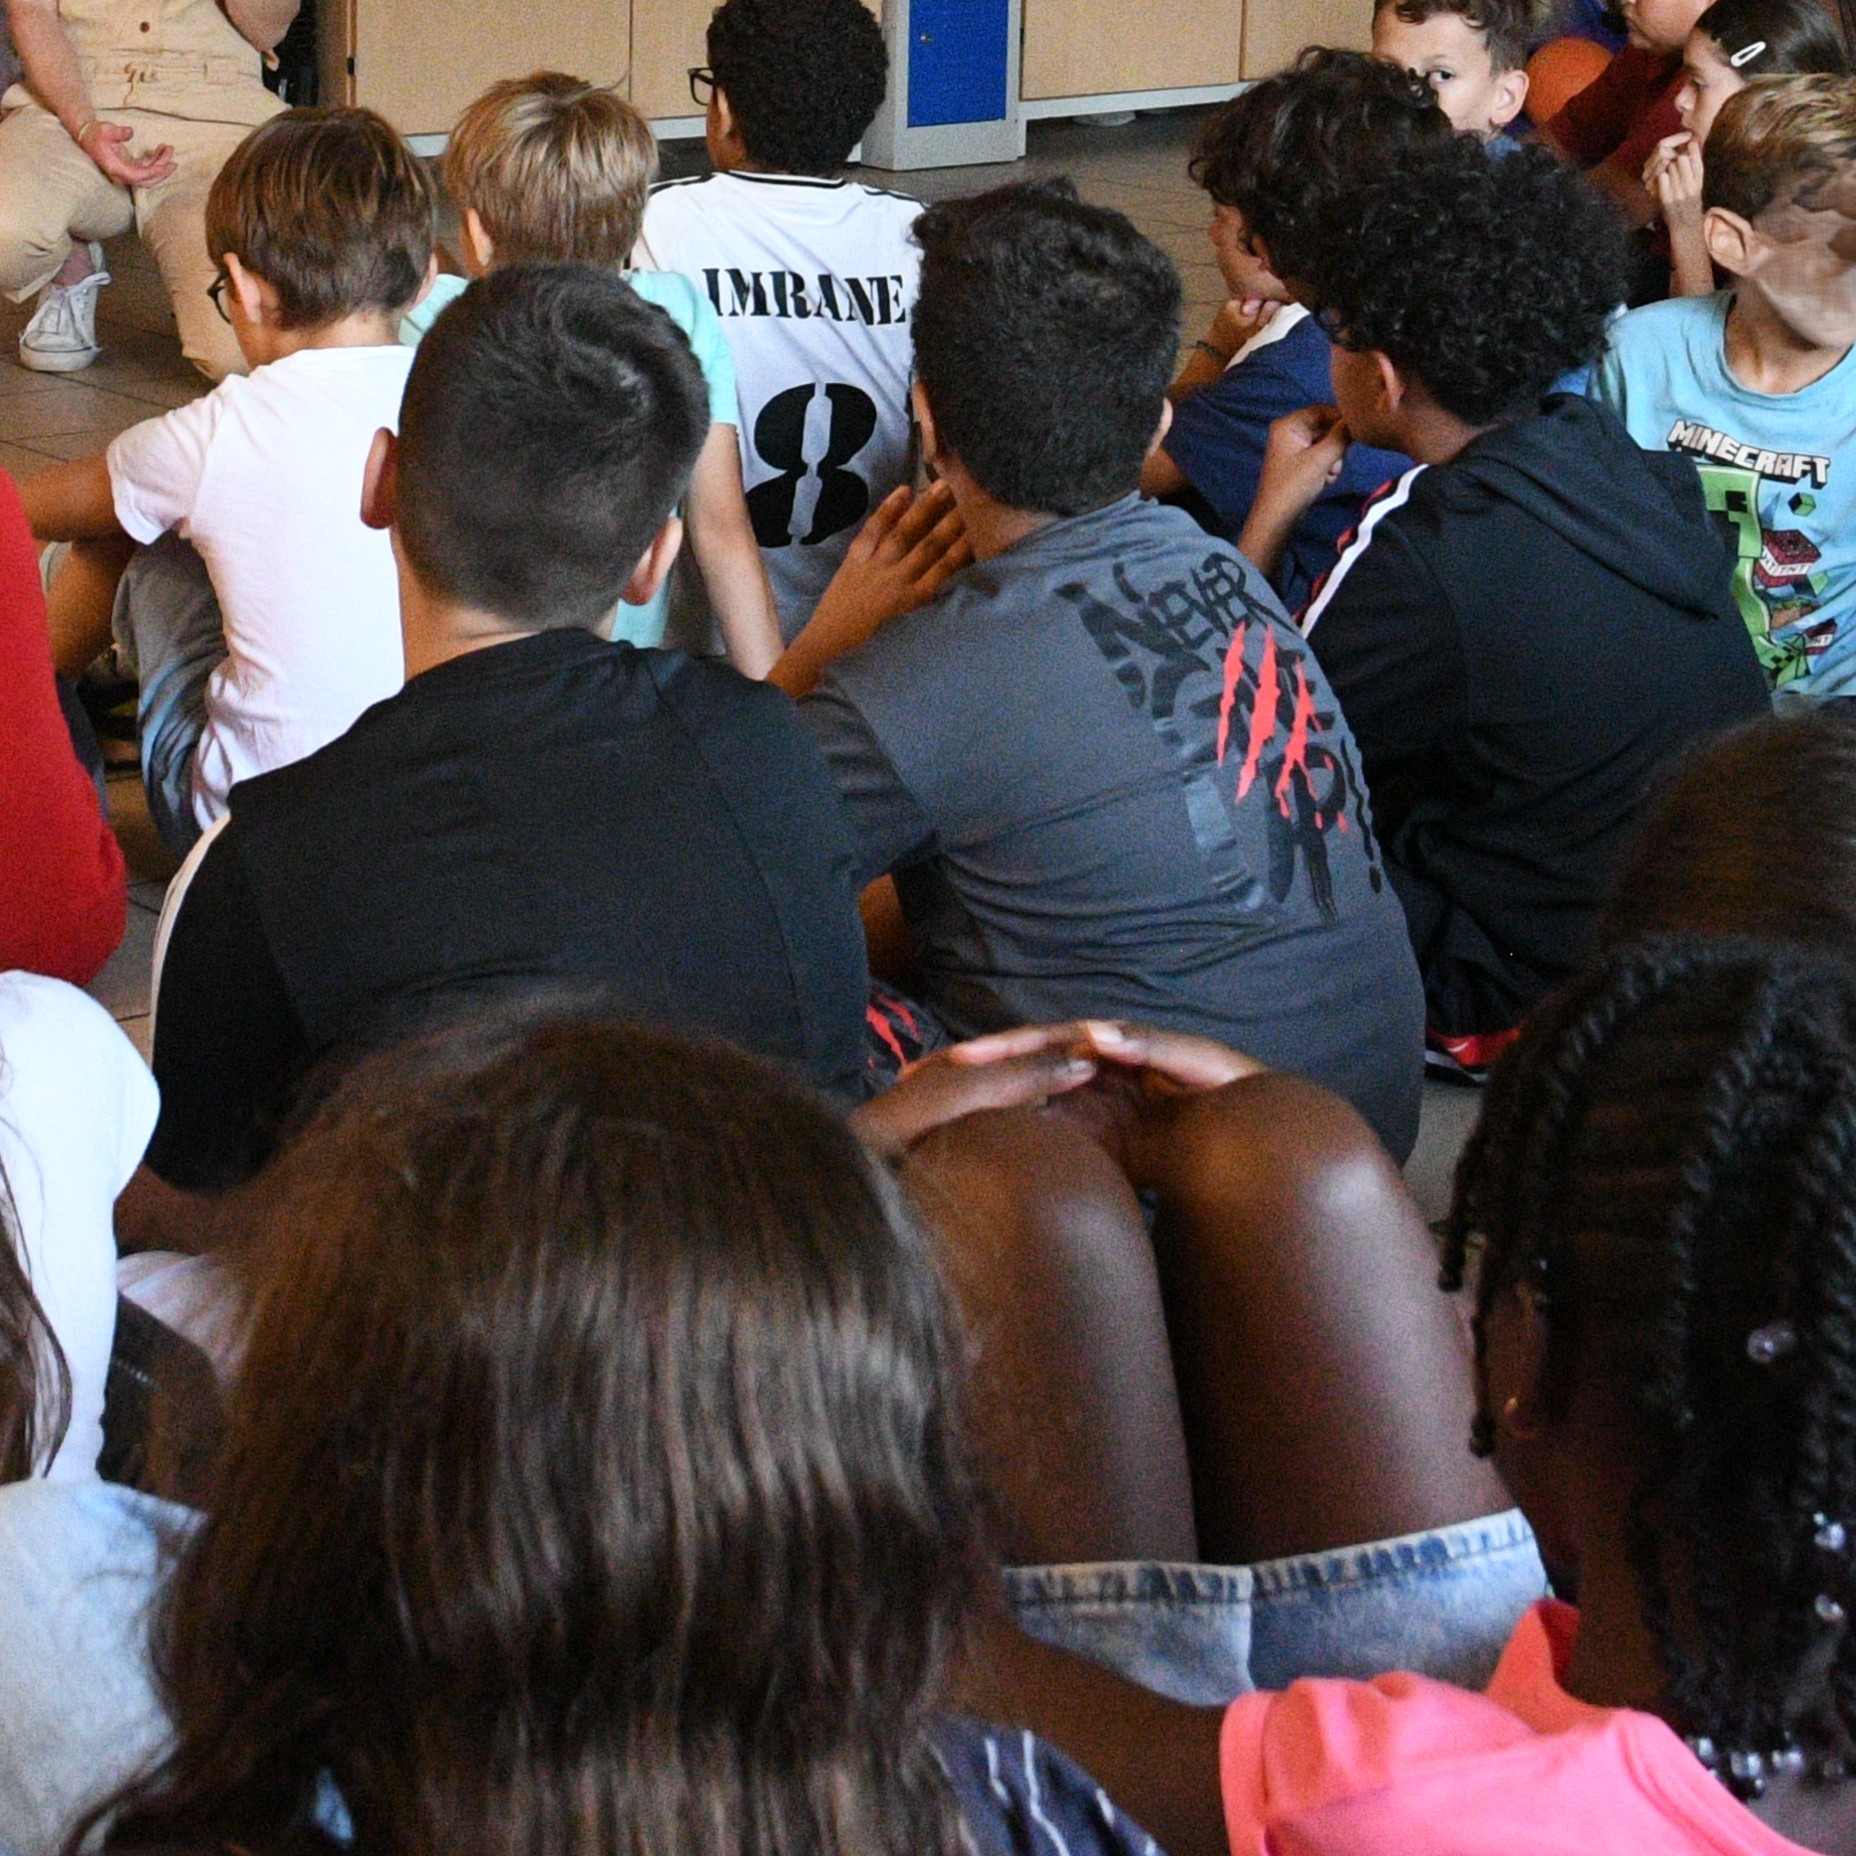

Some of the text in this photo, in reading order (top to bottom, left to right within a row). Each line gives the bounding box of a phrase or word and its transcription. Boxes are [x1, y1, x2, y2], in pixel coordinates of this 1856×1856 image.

[702, 267, 906, 326] IMRANE
[744, 382, 877, 548] 8
[1667, 418, 1830, 490] MINECRAFT
[1778, 563, 1809, 575] TNT
[1053, 552, 1302, 710] NEVER
